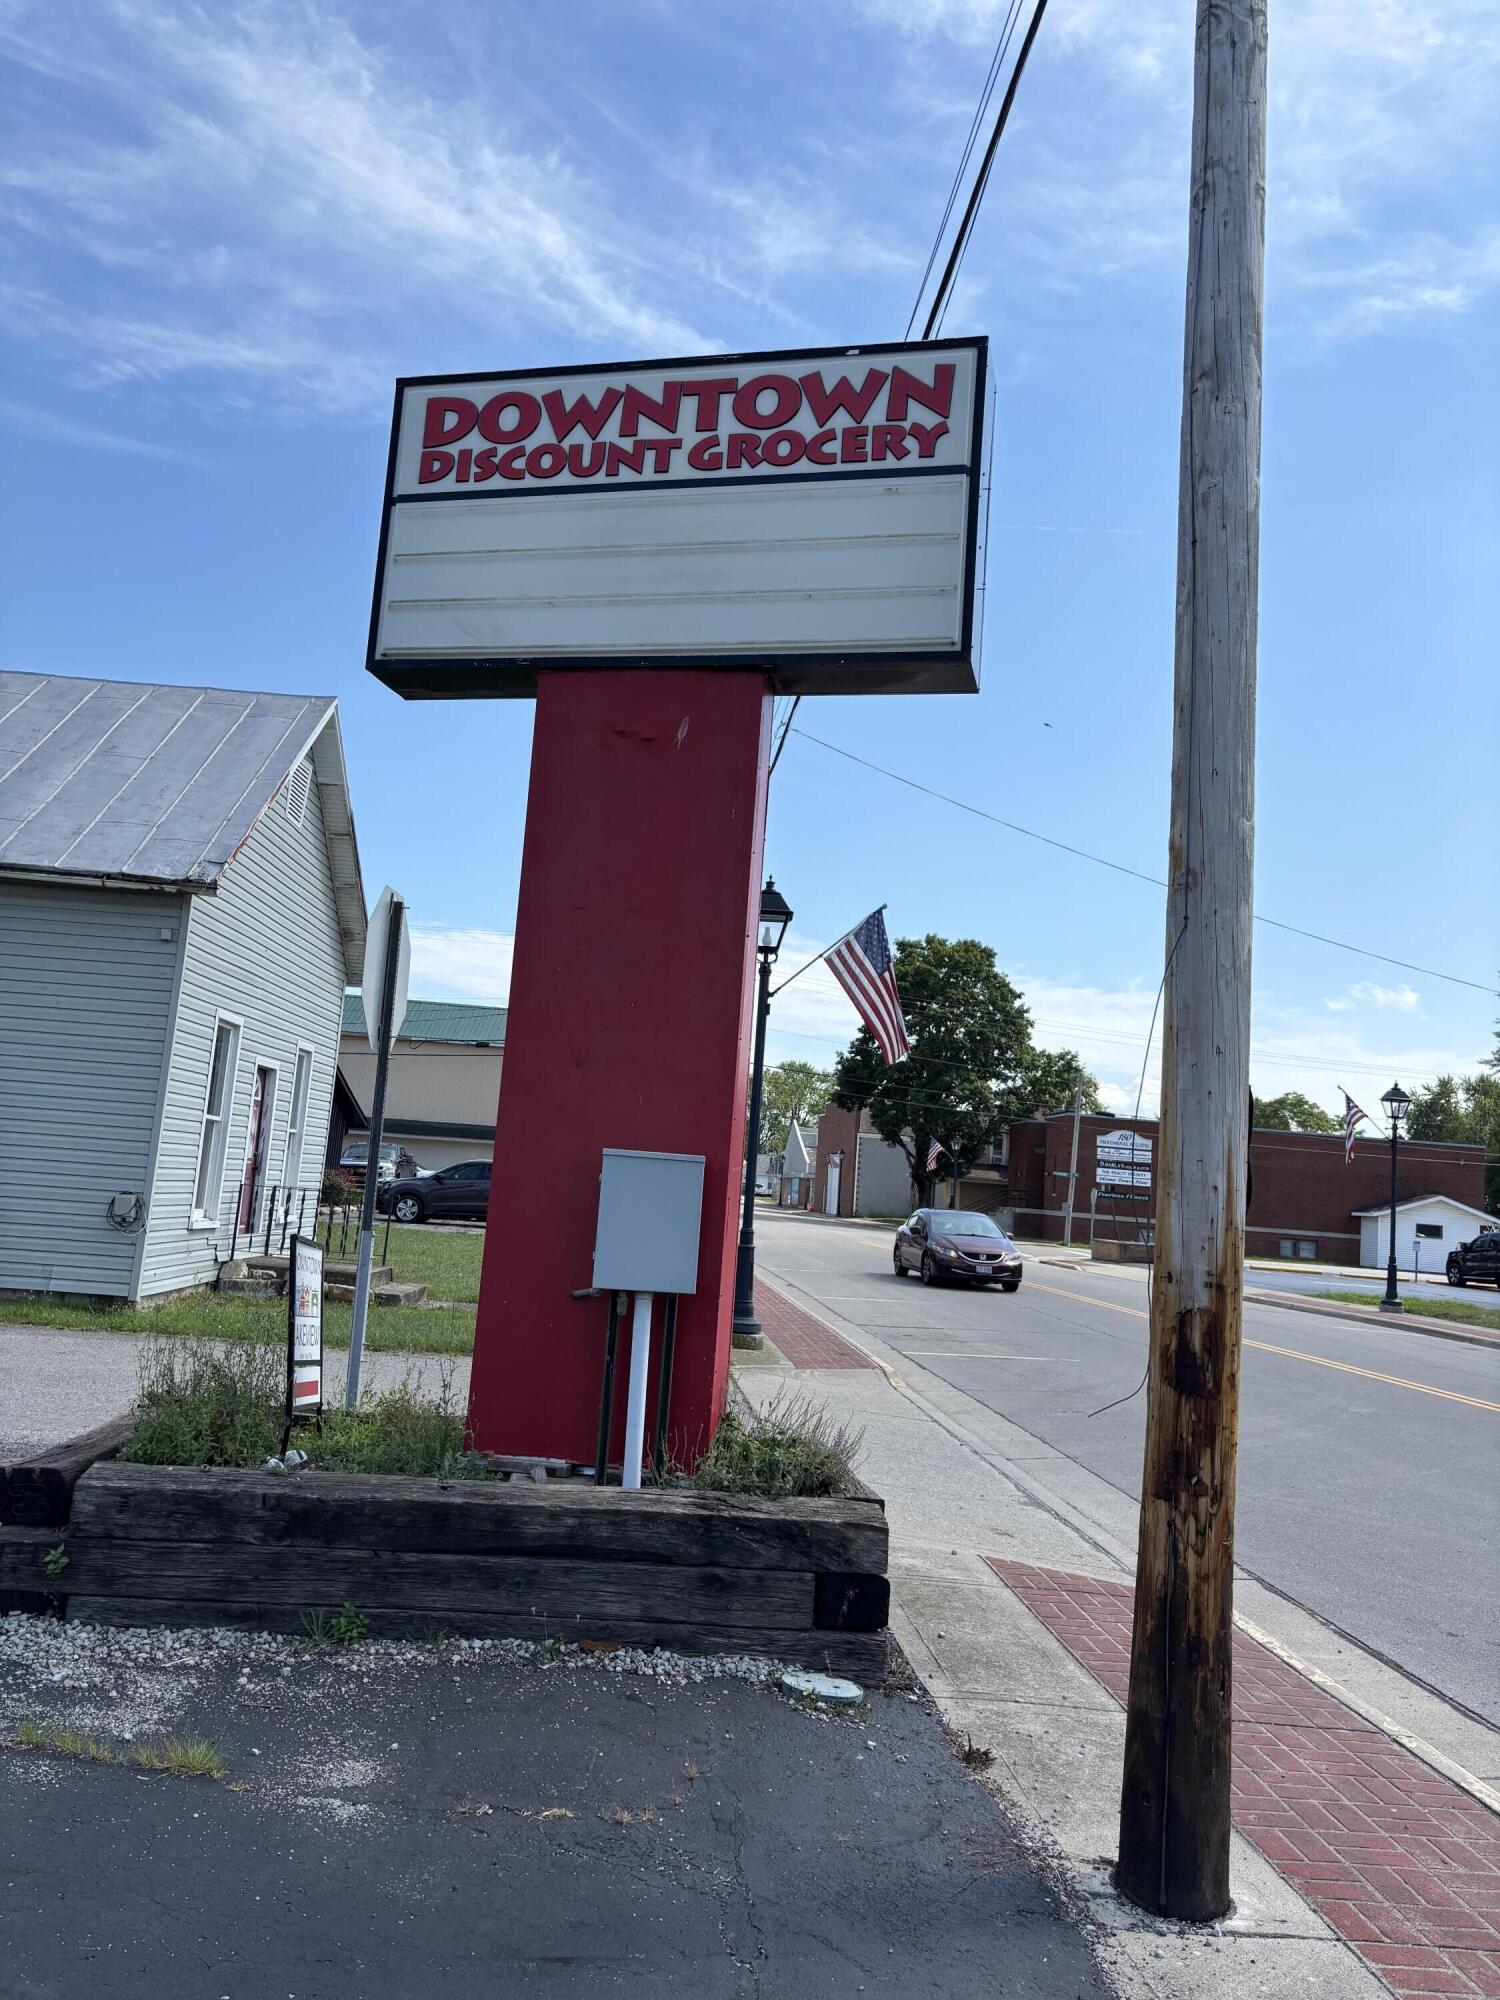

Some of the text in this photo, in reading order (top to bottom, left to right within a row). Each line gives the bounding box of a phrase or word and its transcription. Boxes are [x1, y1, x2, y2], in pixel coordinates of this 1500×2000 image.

[422, 363, 957, 449] DOWNTOWN
[418, 420, 950, 484] DISCOUNT GROCERY
[295, 1252, 322, 1276] OWNTOWN
[294, 1324, 320, 1347] AKEVIEW
